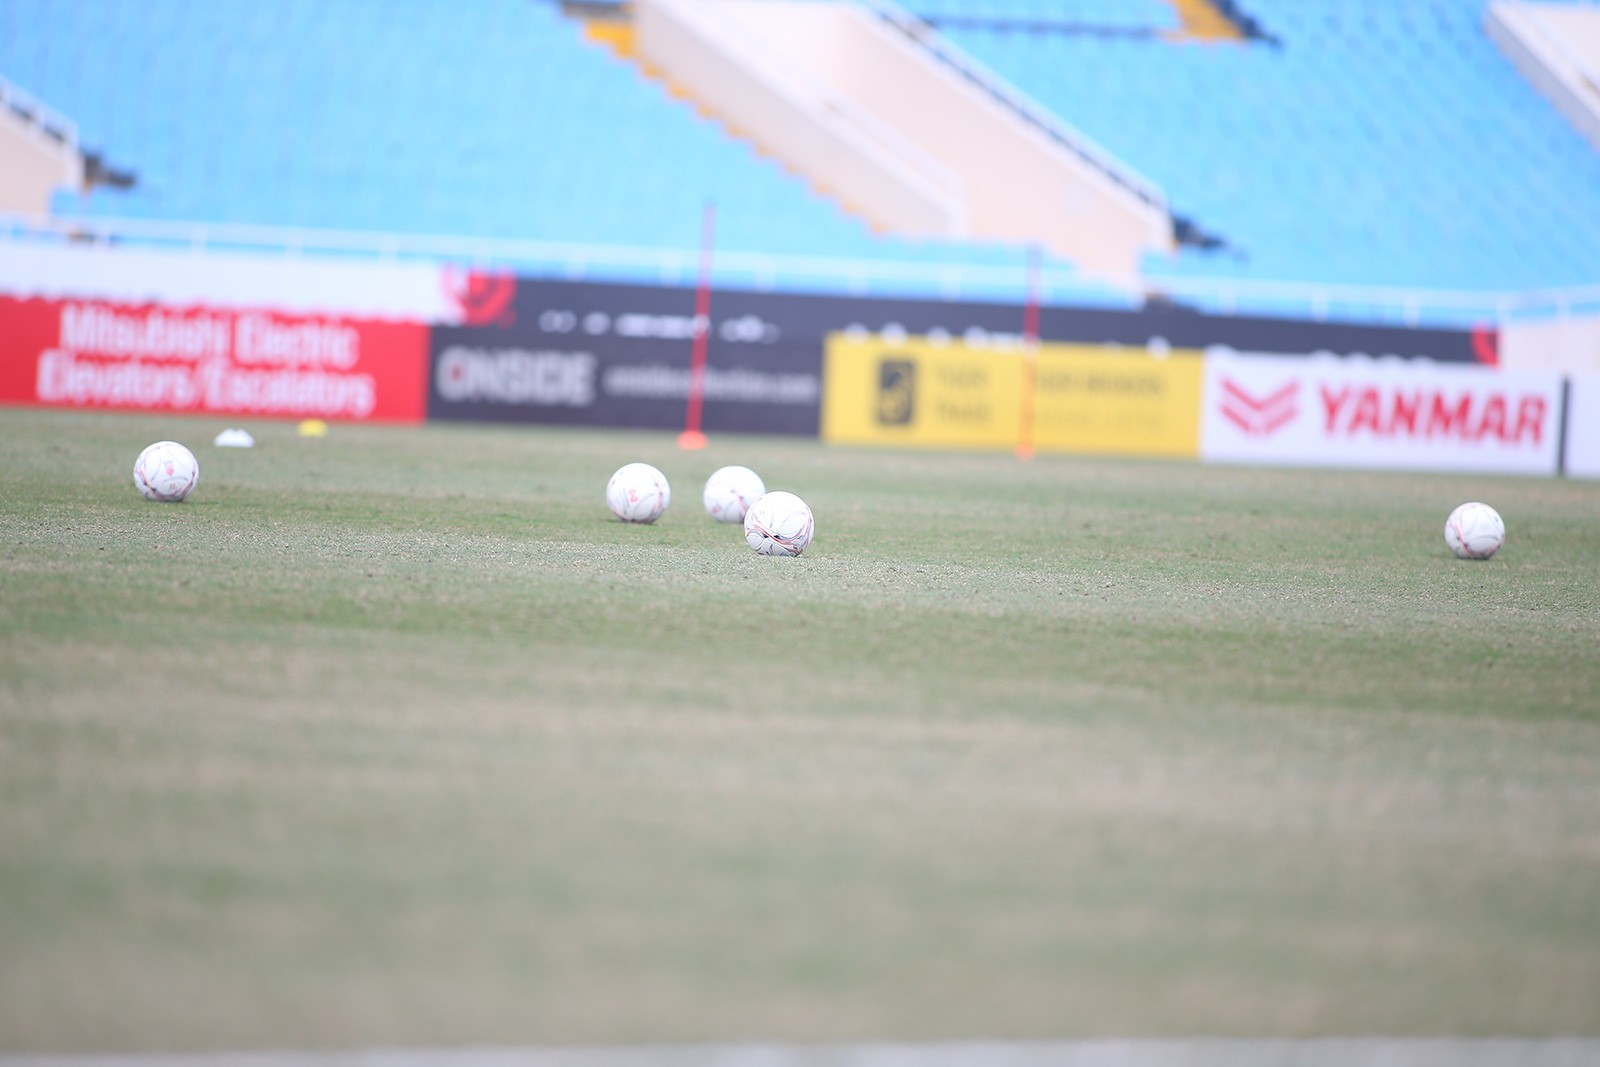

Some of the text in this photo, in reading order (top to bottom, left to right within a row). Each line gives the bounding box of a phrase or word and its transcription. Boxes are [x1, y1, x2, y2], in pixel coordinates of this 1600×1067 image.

[62, 303, 357, 367] Mitsubishi Electric
[438, 348, 596, 404] ONSIDE
[1319, 384, 1547, 446] YANMAR
